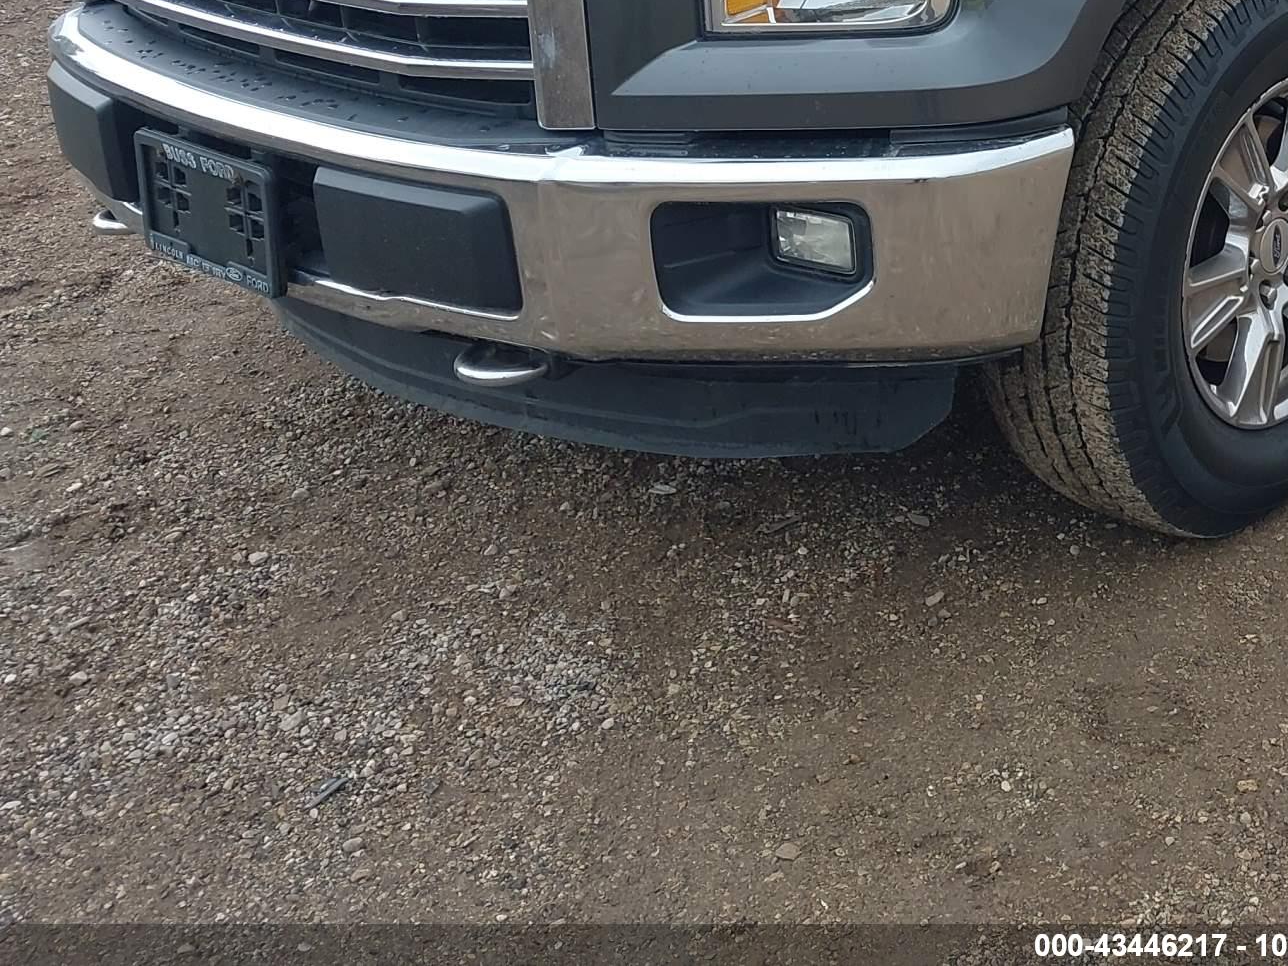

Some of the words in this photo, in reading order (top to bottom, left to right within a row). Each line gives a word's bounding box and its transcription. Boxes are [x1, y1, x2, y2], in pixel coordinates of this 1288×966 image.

[199, 156, 235, 181] FORD
[155, 241, 184, 260] LINCOLN
[246, 275, 269, 294] FORD
